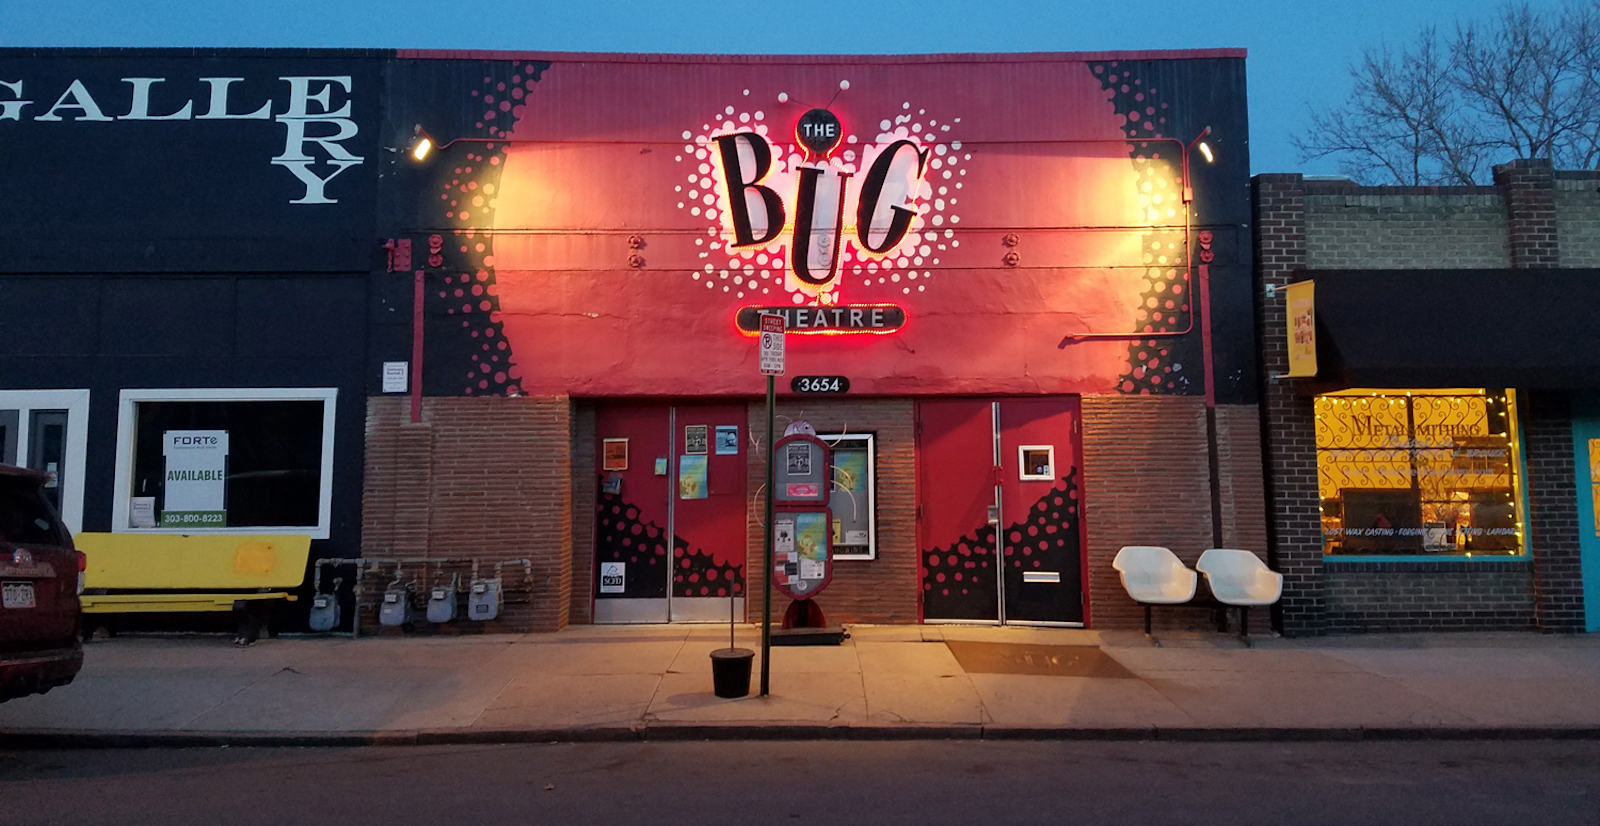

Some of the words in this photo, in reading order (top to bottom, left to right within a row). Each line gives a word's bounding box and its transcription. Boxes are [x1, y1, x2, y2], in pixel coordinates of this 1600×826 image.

[803, 123, 835, 138] THE
[712, 131, 930, 285] BUG
[801, 378, 839, 392] 3654
[167, 470, 223, 481] AVAILABLE
[164, 514, 223, 522] 303-800-8223
[1325, 528, 1343, 536] LOST
[1345, 528, 1362, 536] WAX
[1365, 528, 1394, 536] CASTING
[831, 546, 863, 554] HOWING
